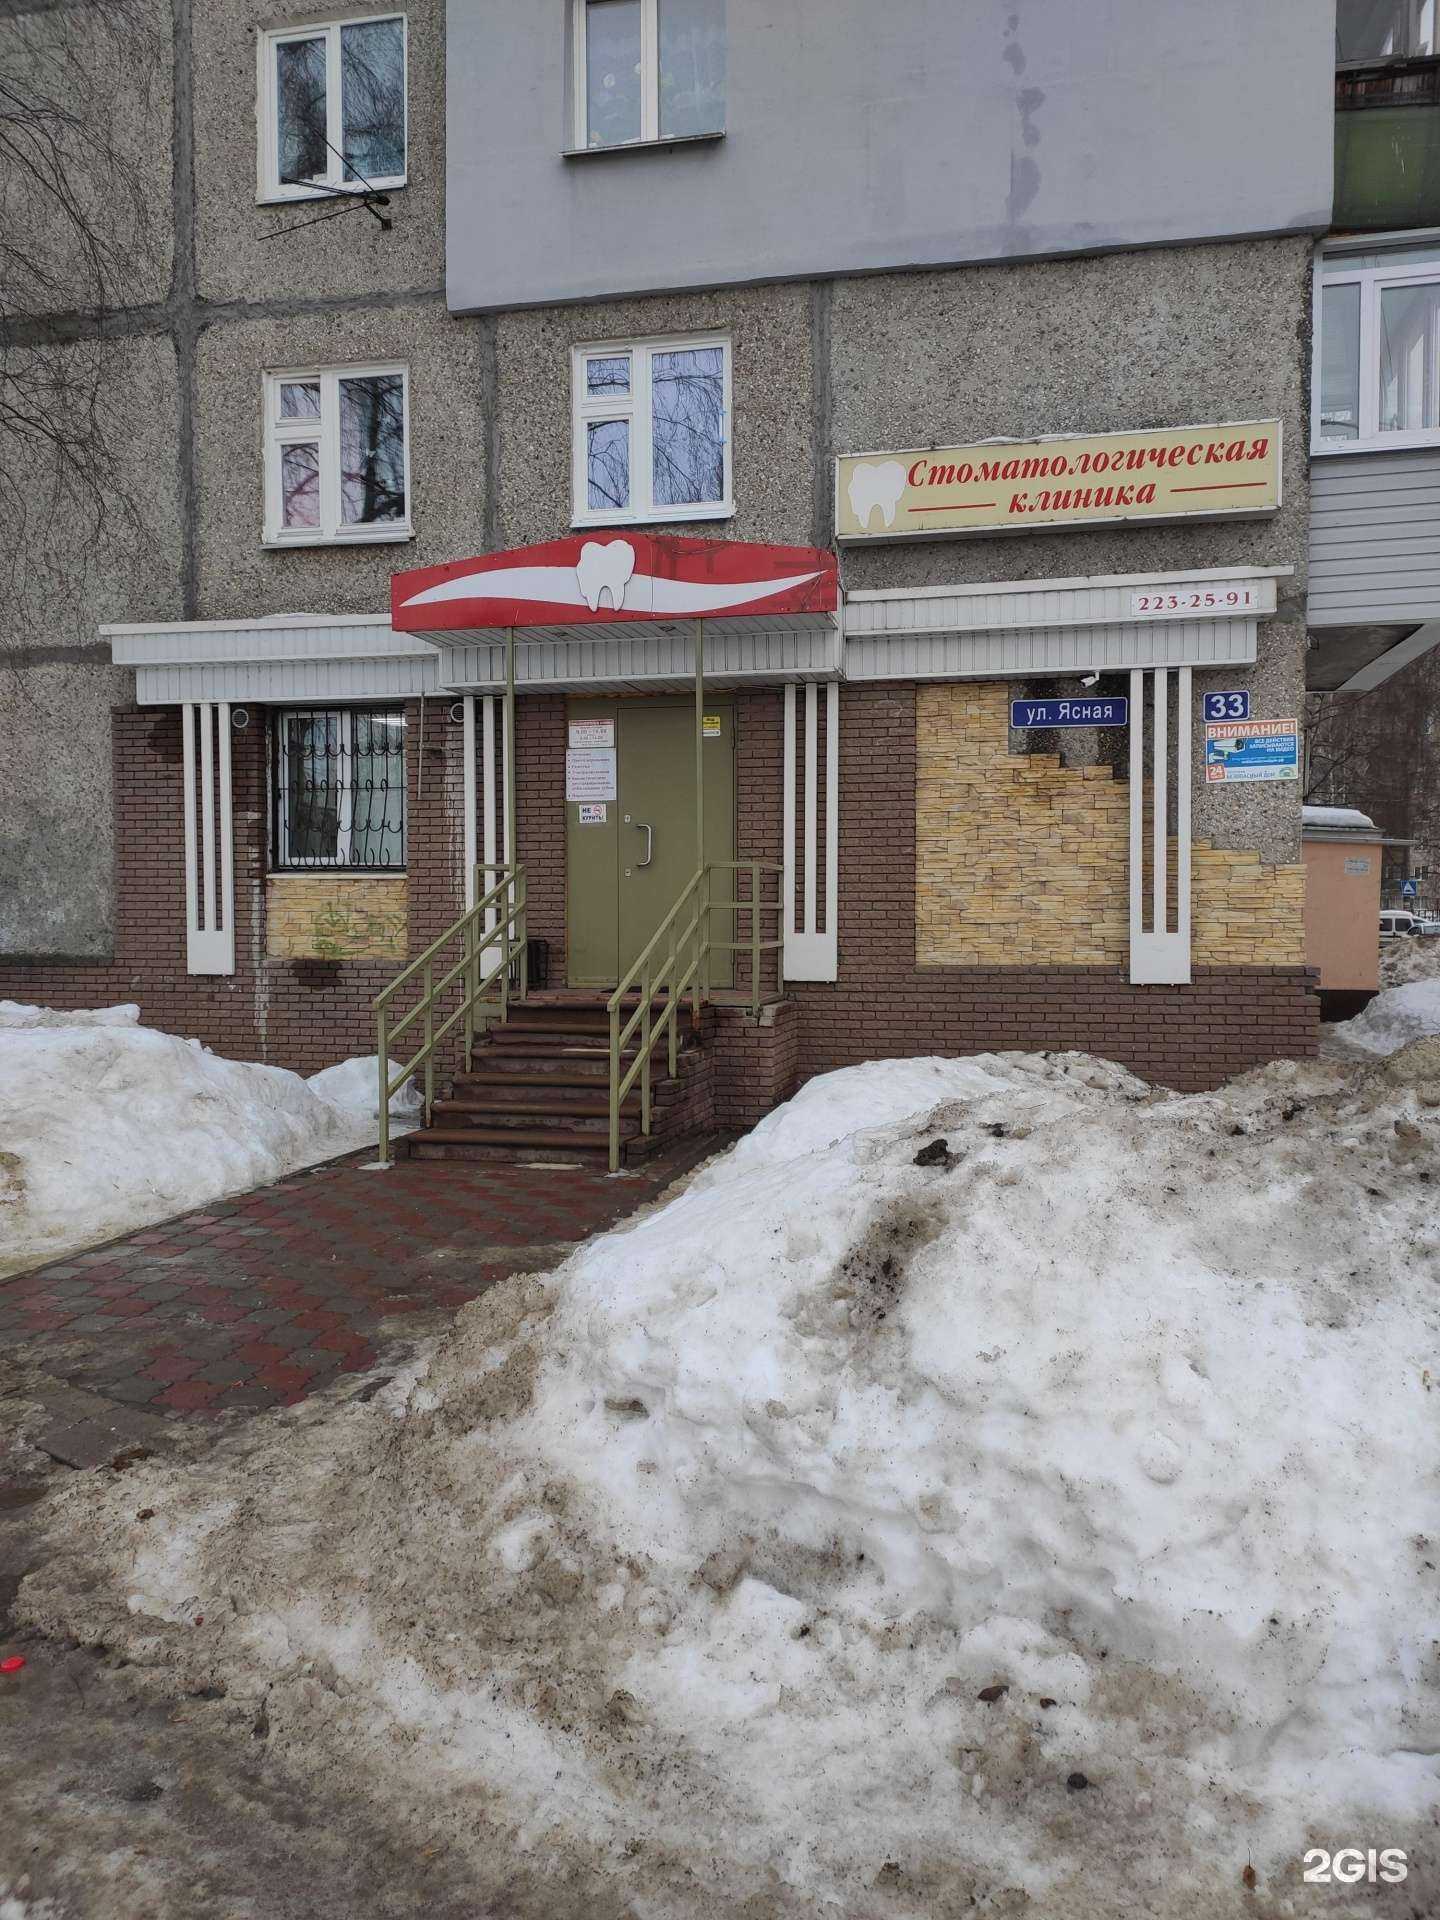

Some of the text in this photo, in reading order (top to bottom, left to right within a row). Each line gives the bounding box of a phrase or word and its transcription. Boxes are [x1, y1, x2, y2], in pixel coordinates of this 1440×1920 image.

[907, 438, 1269, 488] Стоматологическая
[1008, 482, 1157, 514] клиника
[1138, 591, 1250, 610] 223-25-91
[1027, 702, 1113, 725] ул. Ясная
[1210, 694, 1244, 717] 33
[1208, 723, 1295, 738] ВНИМАНИЕ!
